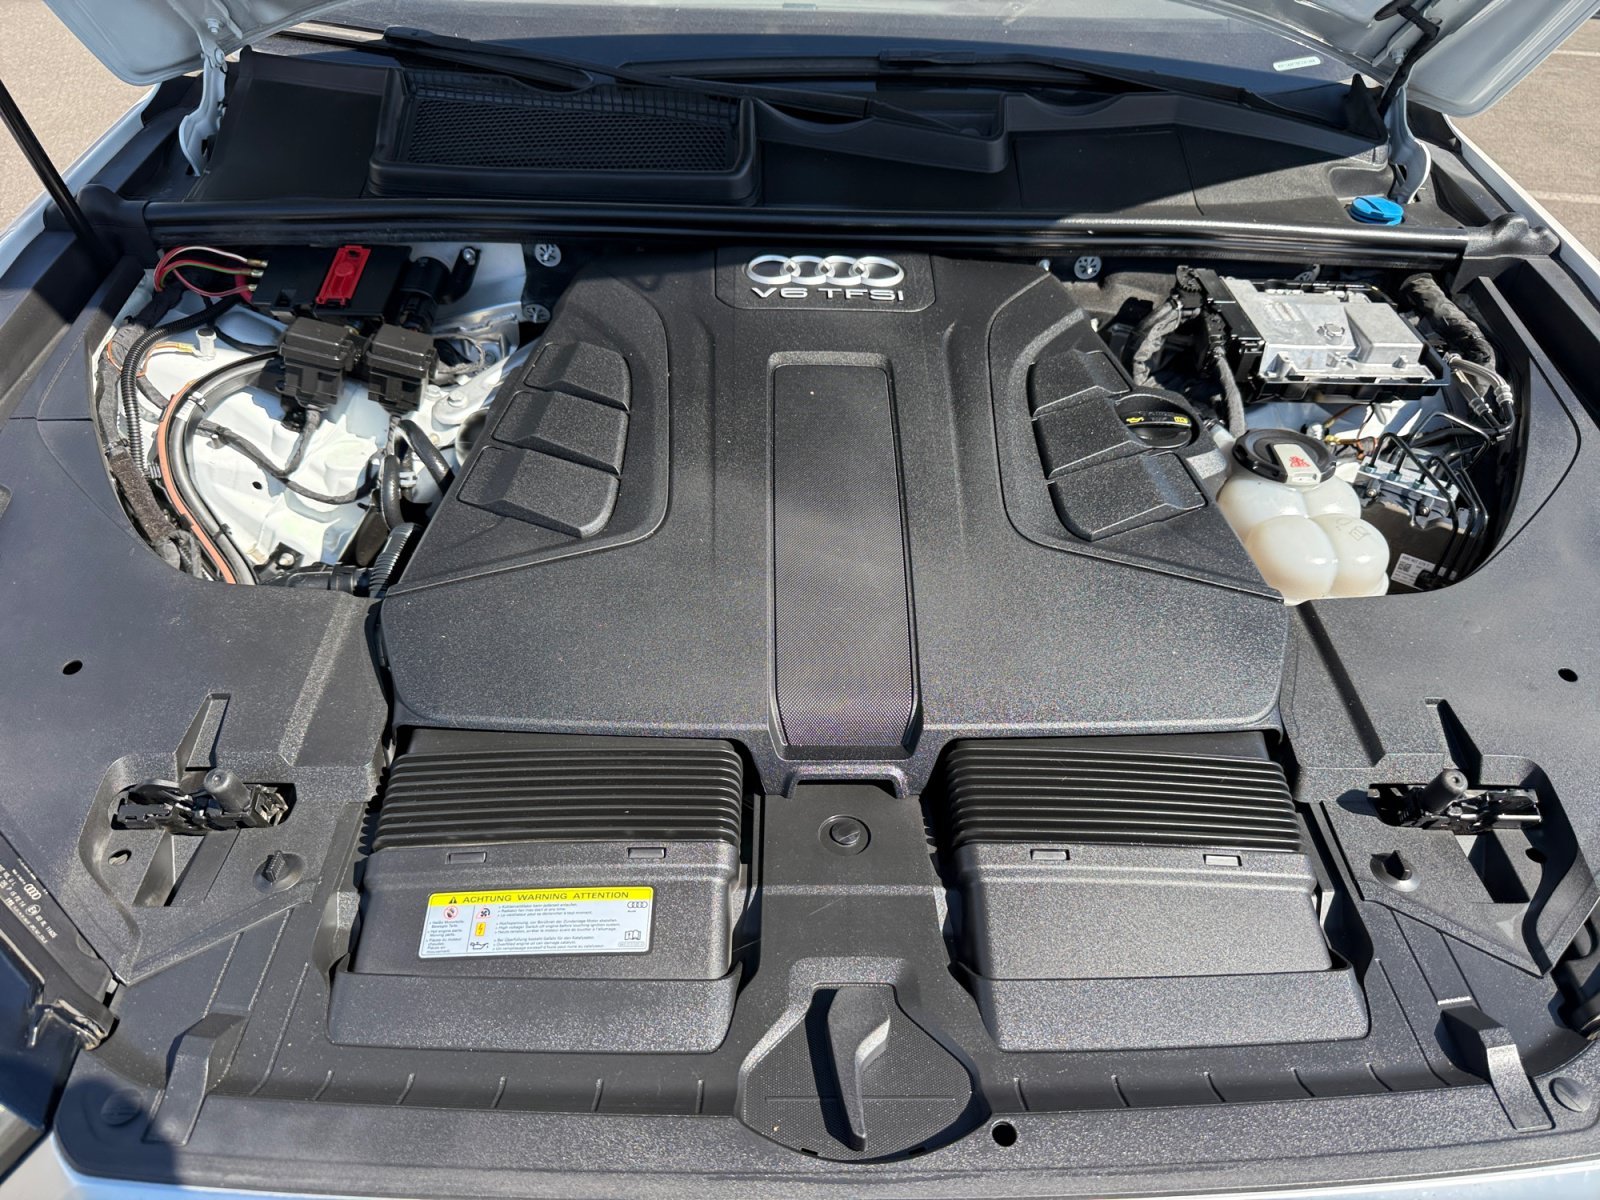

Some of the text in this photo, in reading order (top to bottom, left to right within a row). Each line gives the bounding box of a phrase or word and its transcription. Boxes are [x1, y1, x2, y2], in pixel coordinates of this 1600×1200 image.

[751, 287, 904, 301] V6 TFSI
[463, 891, 629, 904] ACHTUNG WARNING ATTENTION
